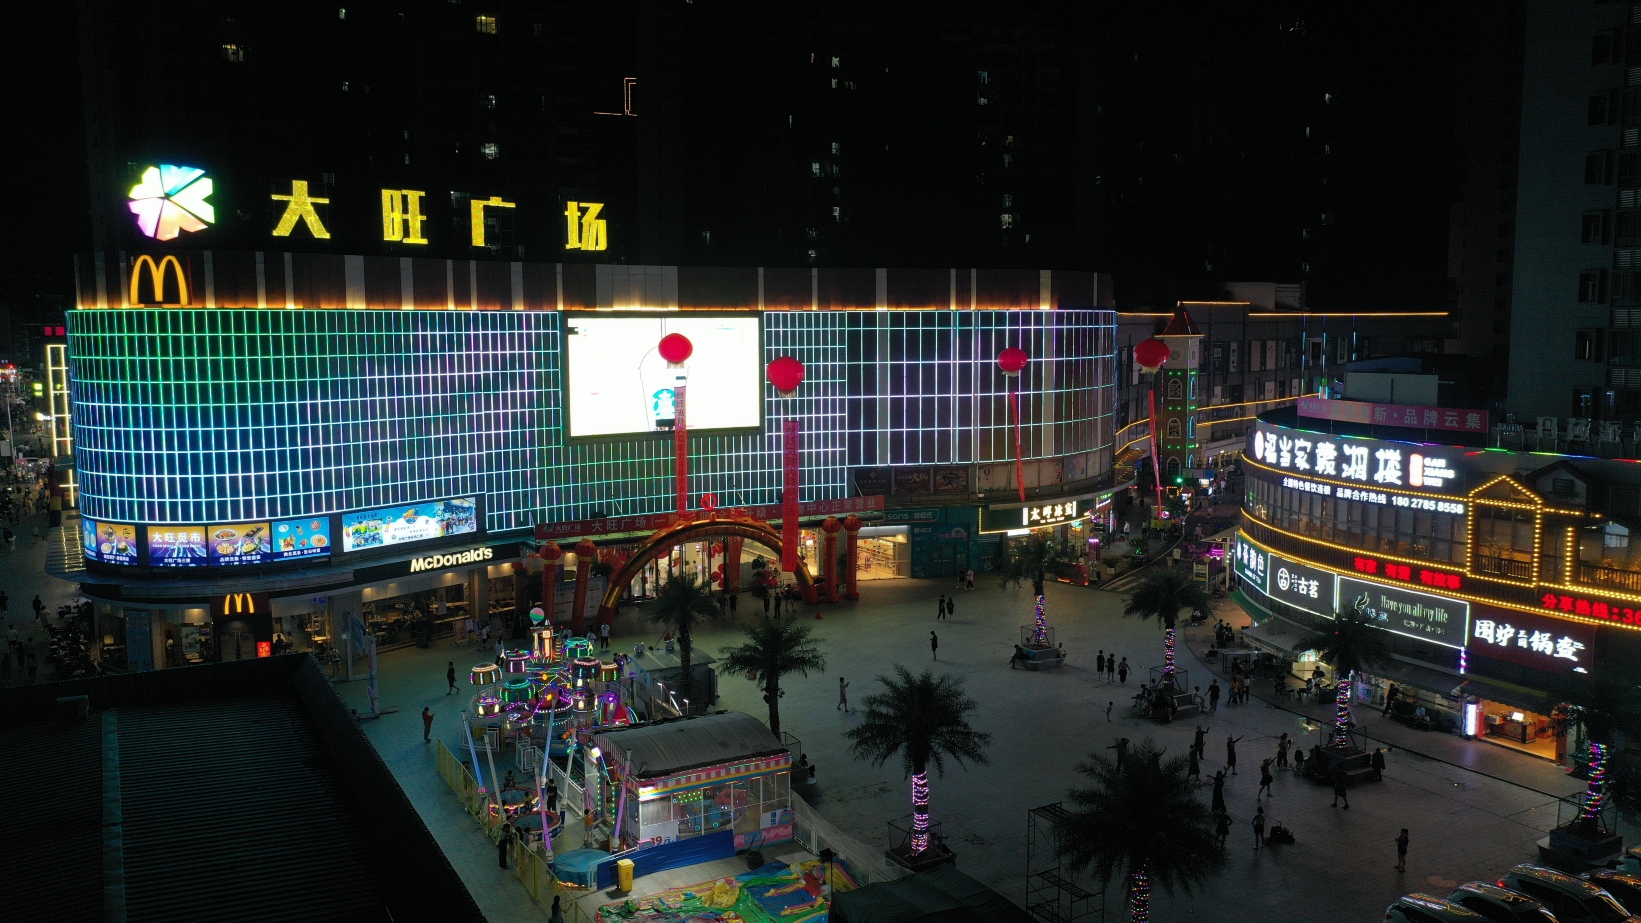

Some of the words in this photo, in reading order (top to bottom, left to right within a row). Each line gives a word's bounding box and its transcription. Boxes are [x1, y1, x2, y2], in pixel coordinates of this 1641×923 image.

[271, 180, 607, 251] 大旺广场
[1336, 488, 1387, 505] 品牌合作热线
[1392, 495, 1410, 508] 180
[1411, 498, 1436, 511] 2785
[1437, 502, 1464, 515] 8558
[152, 532, 201, 543] 大旺觅市
[410, 547, 493, 572] McDonald's
[1298, 576, 1320, 599] 古茗
[1380, 595, 1398, 612] Have
[1397, 602, 1412, 615] you
[1412, 603, 1423, 618] all
[1423, 607, 1434, 621] my
[1435, 606, 1449, 624] life
